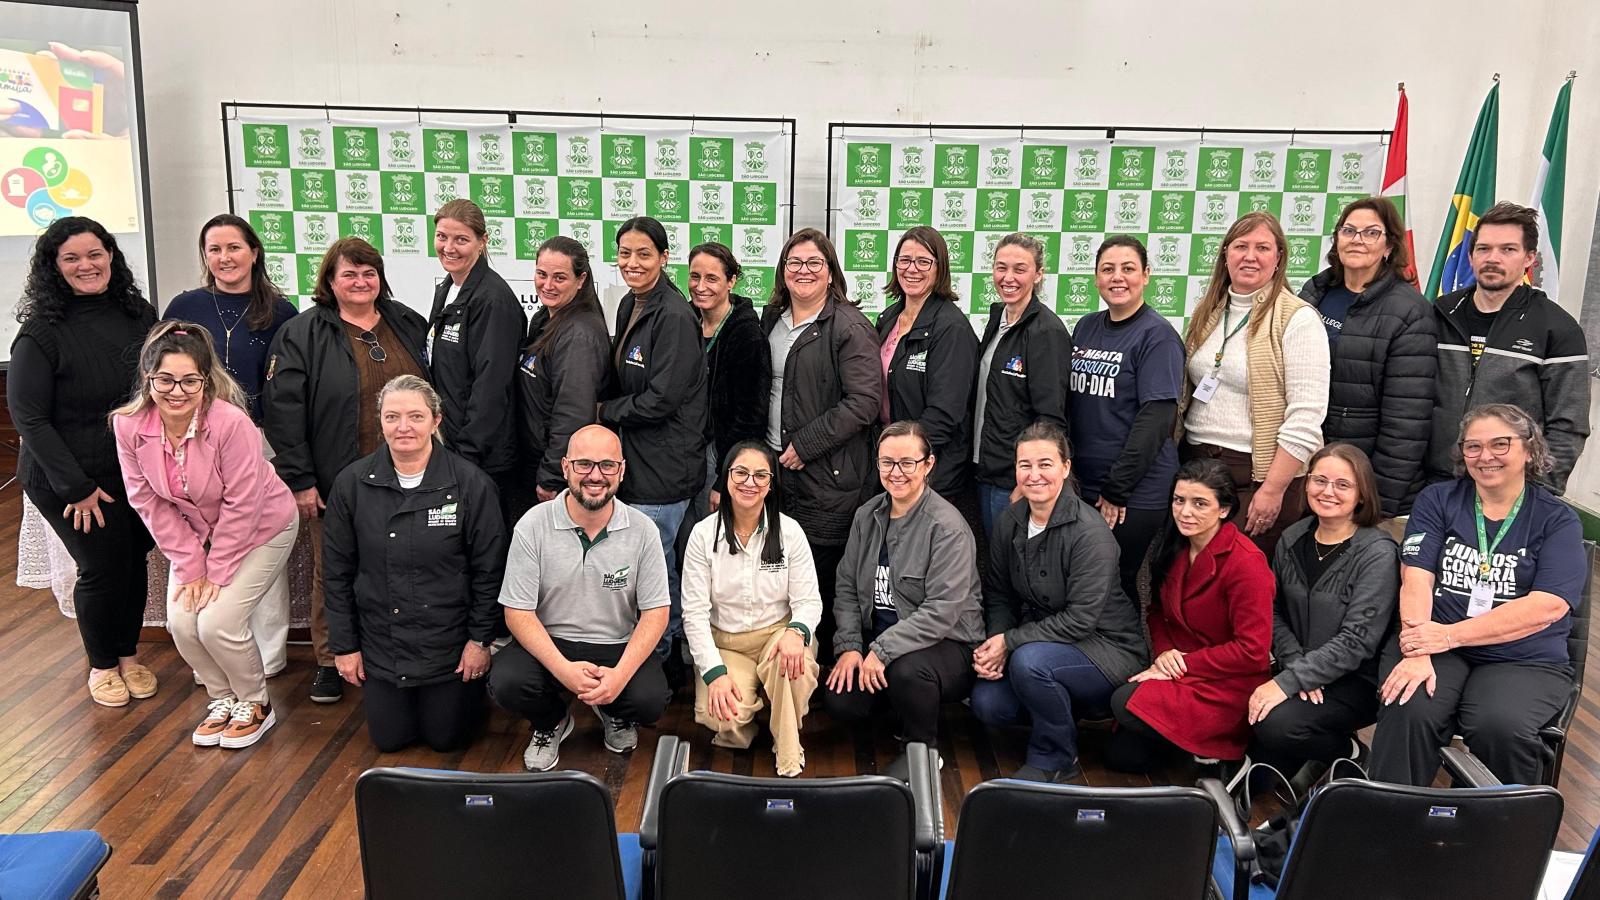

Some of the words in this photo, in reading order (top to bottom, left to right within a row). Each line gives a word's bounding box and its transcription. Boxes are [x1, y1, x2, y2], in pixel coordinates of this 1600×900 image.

[1446, 543, 1518, 568] JUNOS
[1442, 556, 1515, 582] CONRA
[1440, 571, 1517, 595] DENUE
